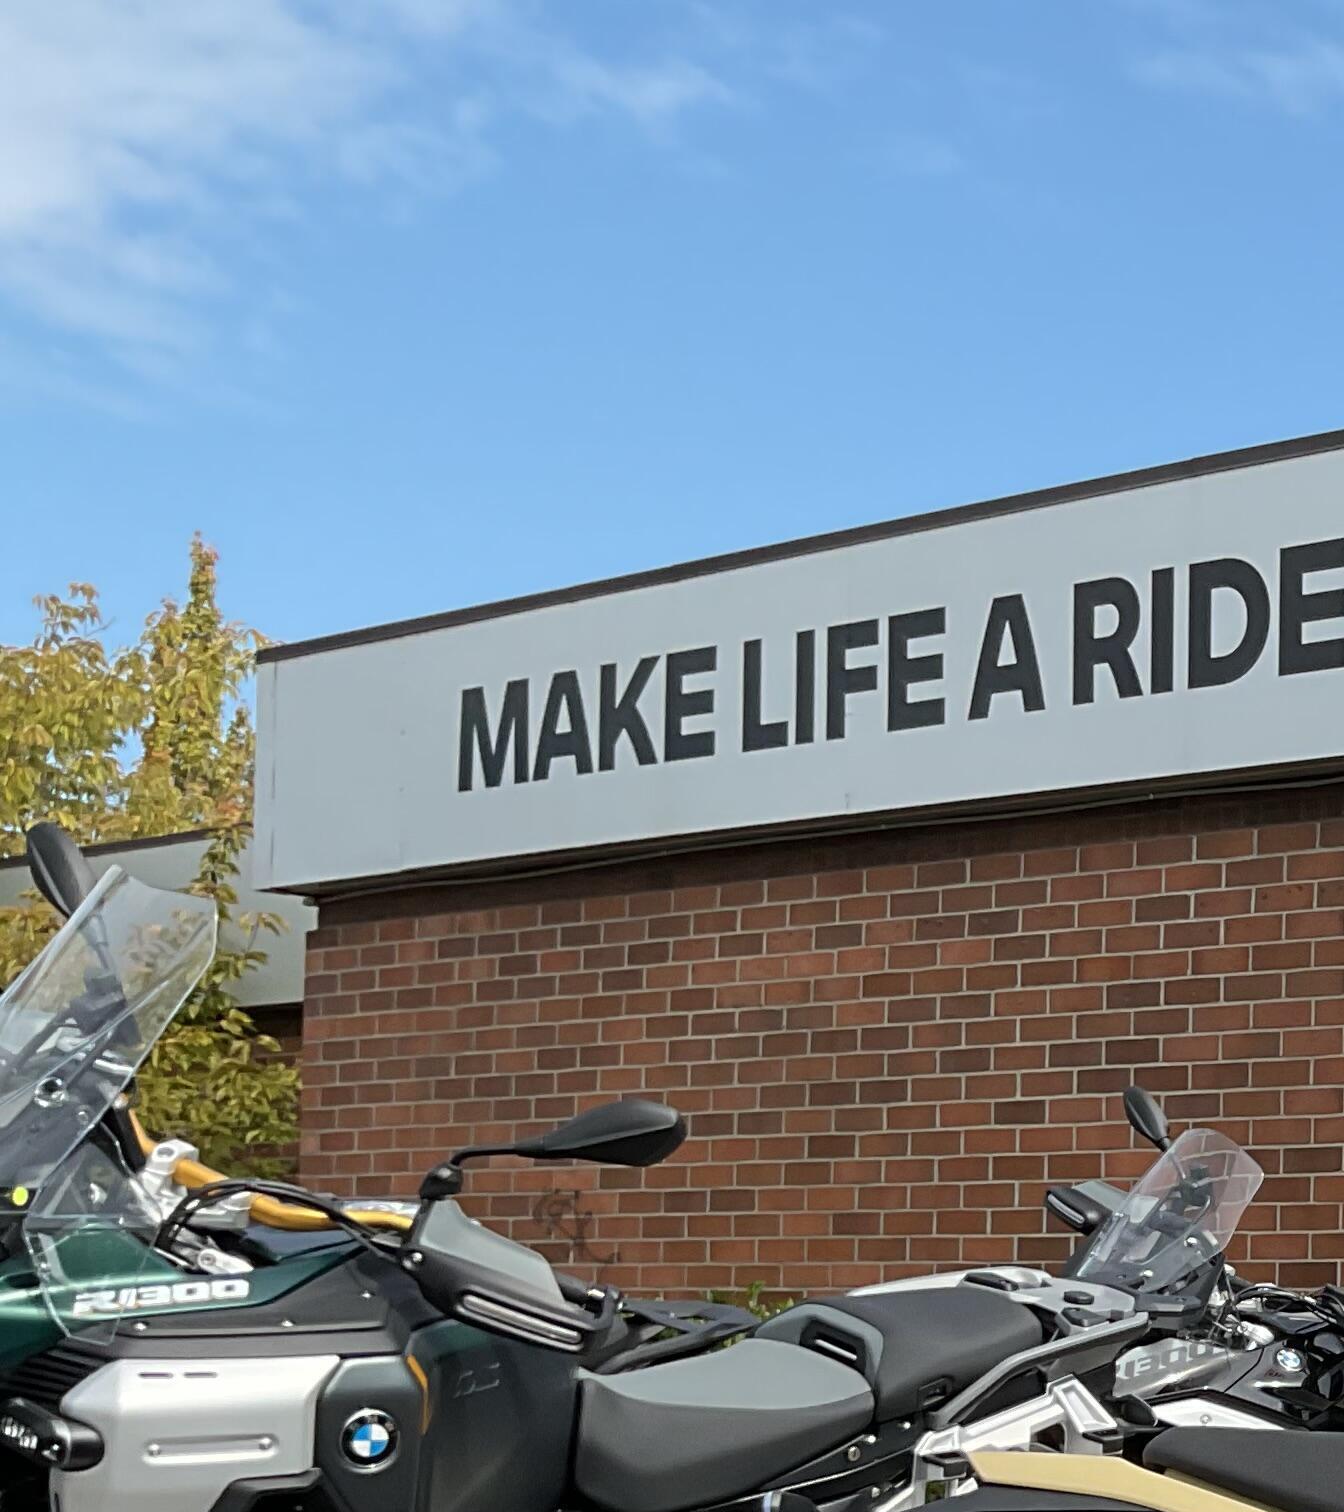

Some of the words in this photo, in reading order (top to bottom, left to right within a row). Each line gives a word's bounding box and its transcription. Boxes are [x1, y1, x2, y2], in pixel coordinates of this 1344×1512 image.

[457, 645, 717, 793] MAKE
[742, 605, 946, 754] LIFE
[967, 593, 1046, 721] A
